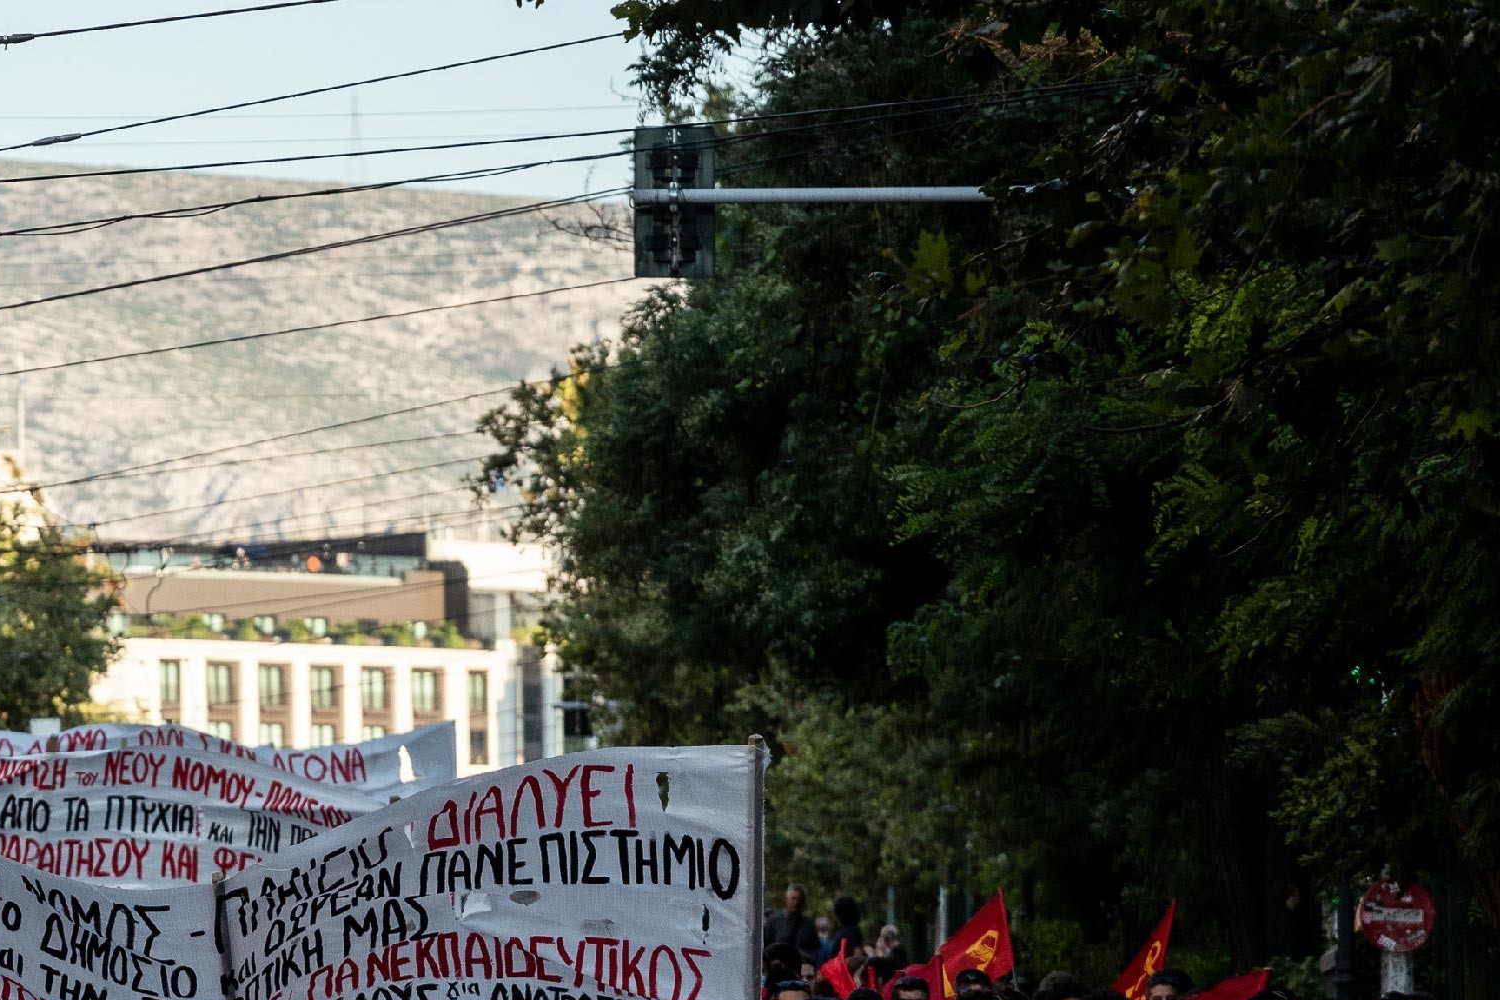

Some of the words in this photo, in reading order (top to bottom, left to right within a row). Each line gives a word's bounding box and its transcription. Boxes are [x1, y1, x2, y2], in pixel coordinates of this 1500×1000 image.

[103, 751, 166, 788] ΝΕΟΥ
[0, 794, 50, 832] ΑΠΟ
[64, 796, 89, 832] ΤΑ
[105, 795, 194, 834] ΠΤΥΧΙΑ
[242, 809, 280, 853] ΤΗΝ
[428, 763, 636, 851] ΔΙΑΛΥΕΙ
[161, 838, 198, 882] ΚΑΙ
[40, 912, 198, 998] ΔΗΜΟΣΙΟ
[419, 829, 740, 901] ΠΑΝΕΠΙΣΤΗΜΙΟ
[343, 895, 439, 958] ΜΑΣ
